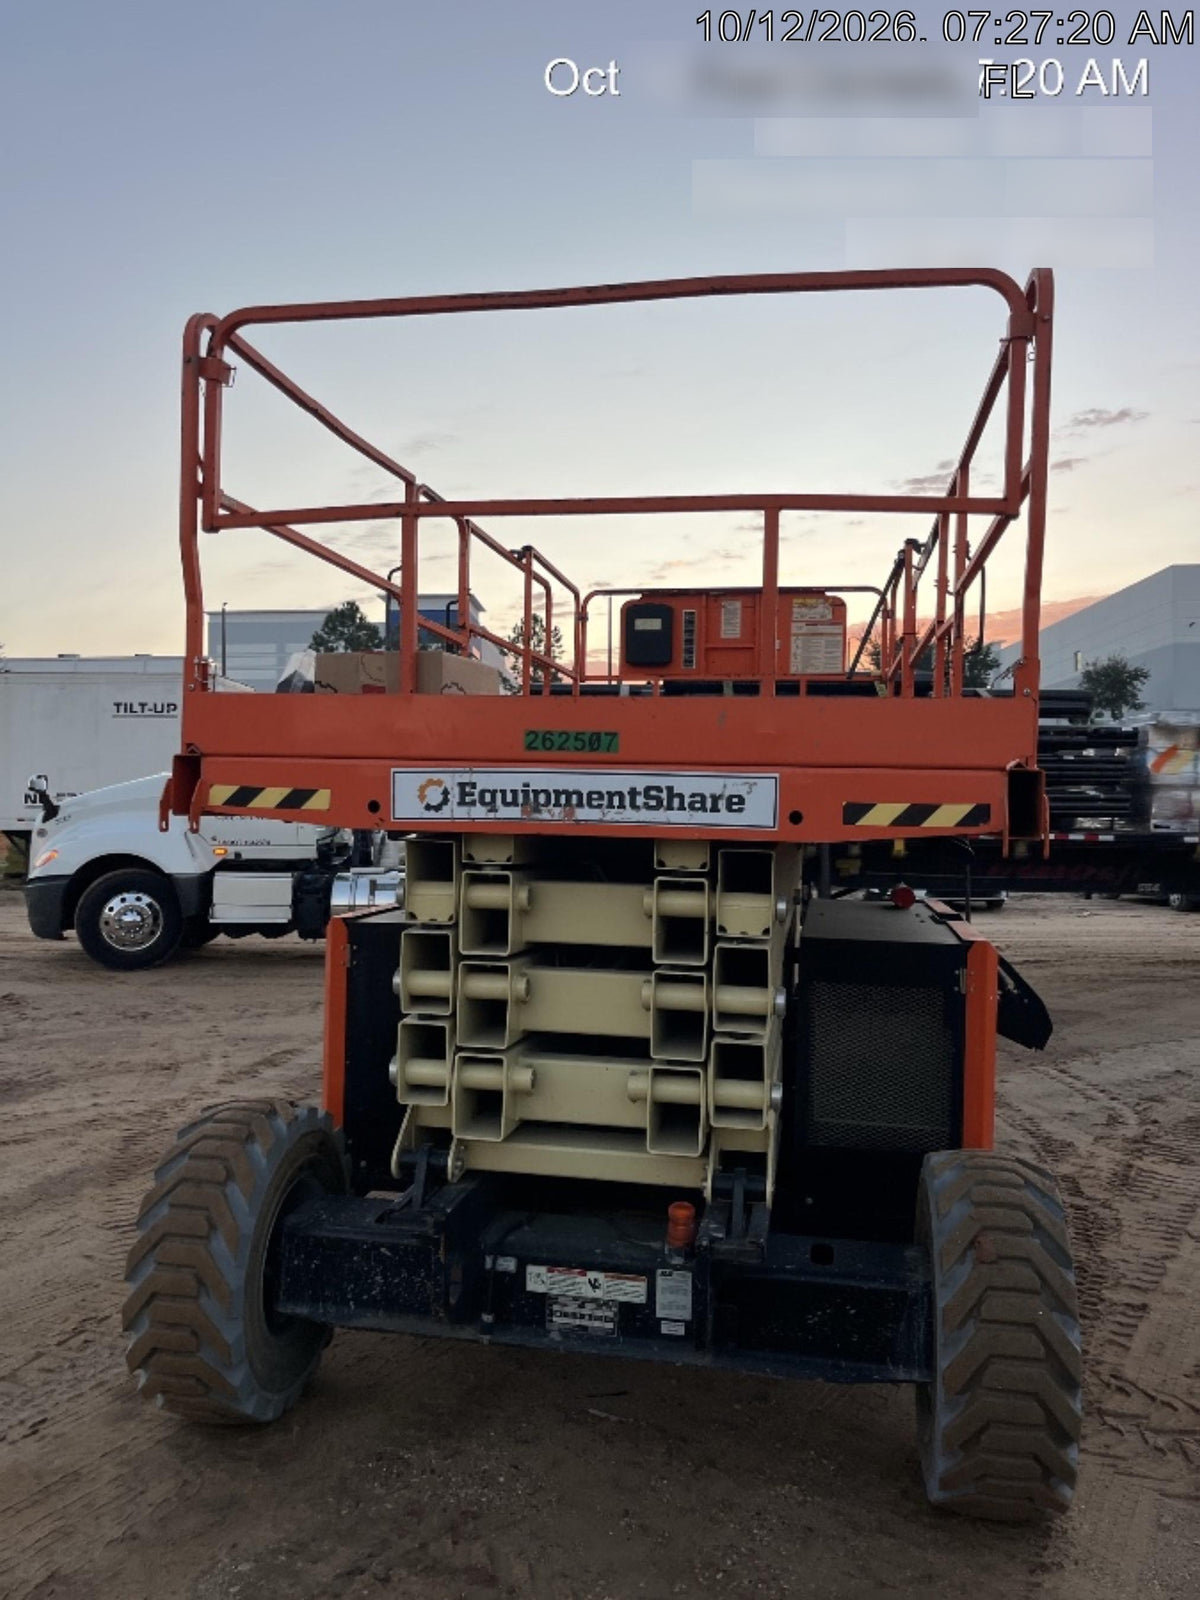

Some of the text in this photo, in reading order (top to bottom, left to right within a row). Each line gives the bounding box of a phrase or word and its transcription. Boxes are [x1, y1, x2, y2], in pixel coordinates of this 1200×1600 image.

[113, 702, 178, 715] TILT-UP
[525, 731, 617, 751] 262507
[456, 781, 746, 817] EquipmentShare
